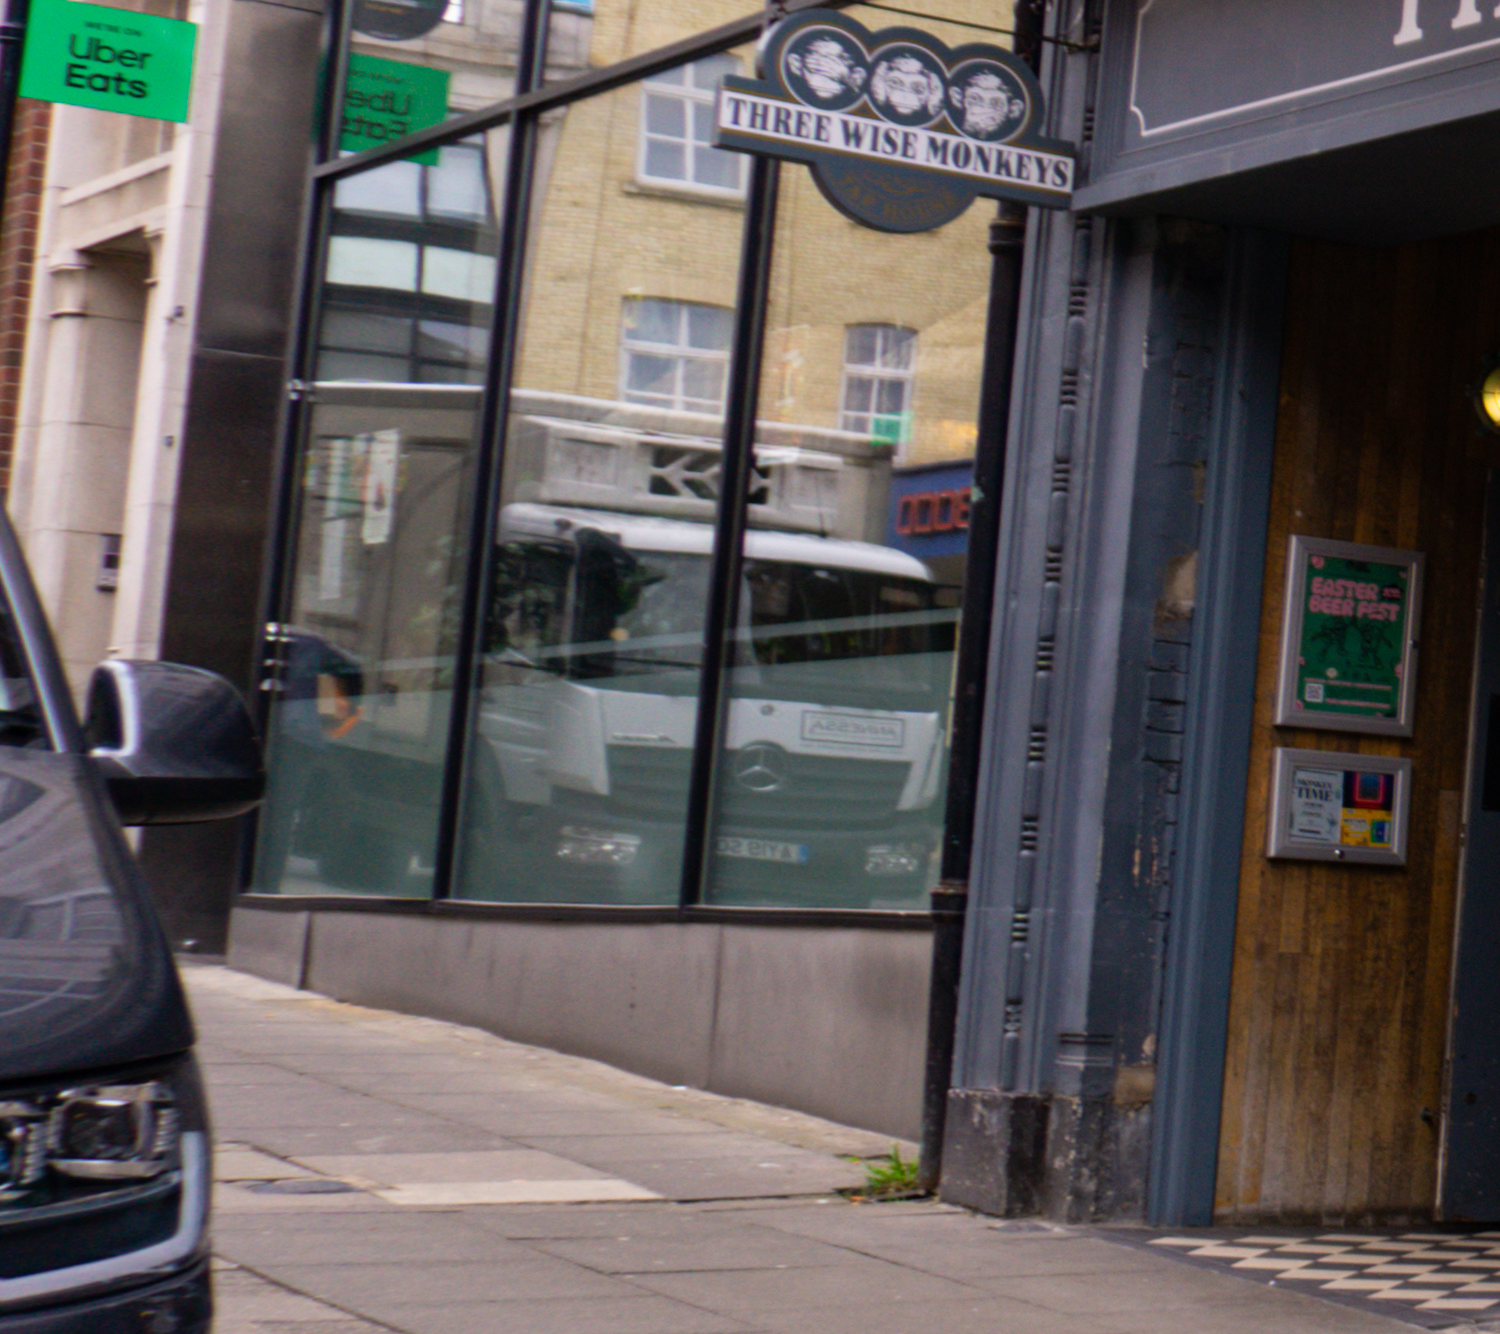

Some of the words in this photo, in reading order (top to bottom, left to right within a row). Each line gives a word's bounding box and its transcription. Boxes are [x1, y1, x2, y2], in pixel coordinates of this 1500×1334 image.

[67, 32, 153, 70] Uber
[63, 62, 148, 99] Eats
[727, 96, 833, 144] THREE
[840, 120, 919, 160] WISE
[925, 135, 1070, 189] MONKEYS
[1310, 575, 1380, 602] EASTER
[1308, 593, 1356, 618] BEER
[1356, 601, 1401, 623] FEST
[1296, 786, 1334, 803] TIME
